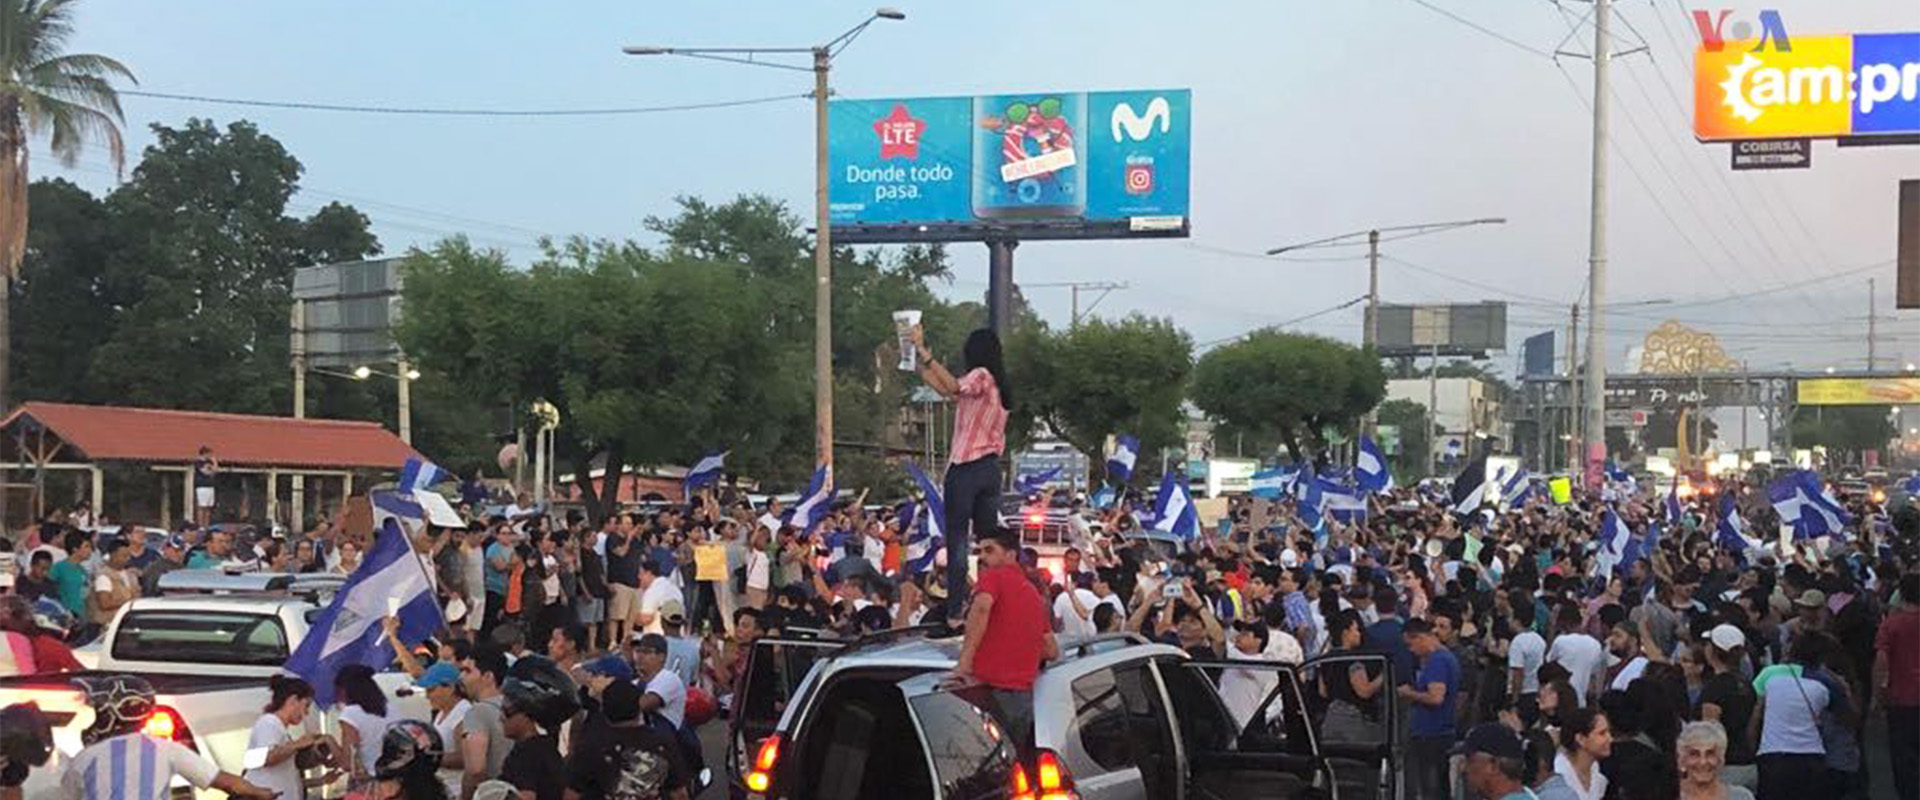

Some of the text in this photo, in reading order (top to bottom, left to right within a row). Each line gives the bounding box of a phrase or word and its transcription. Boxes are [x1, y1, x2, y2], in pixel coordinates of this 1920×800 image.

[883, 128, 916, 145] LTE
[1739, 141, 1802, 154] COBIRSA
[846, 162, 954, 183] Donde todo
[875, 183, 923, 203] pasa.
